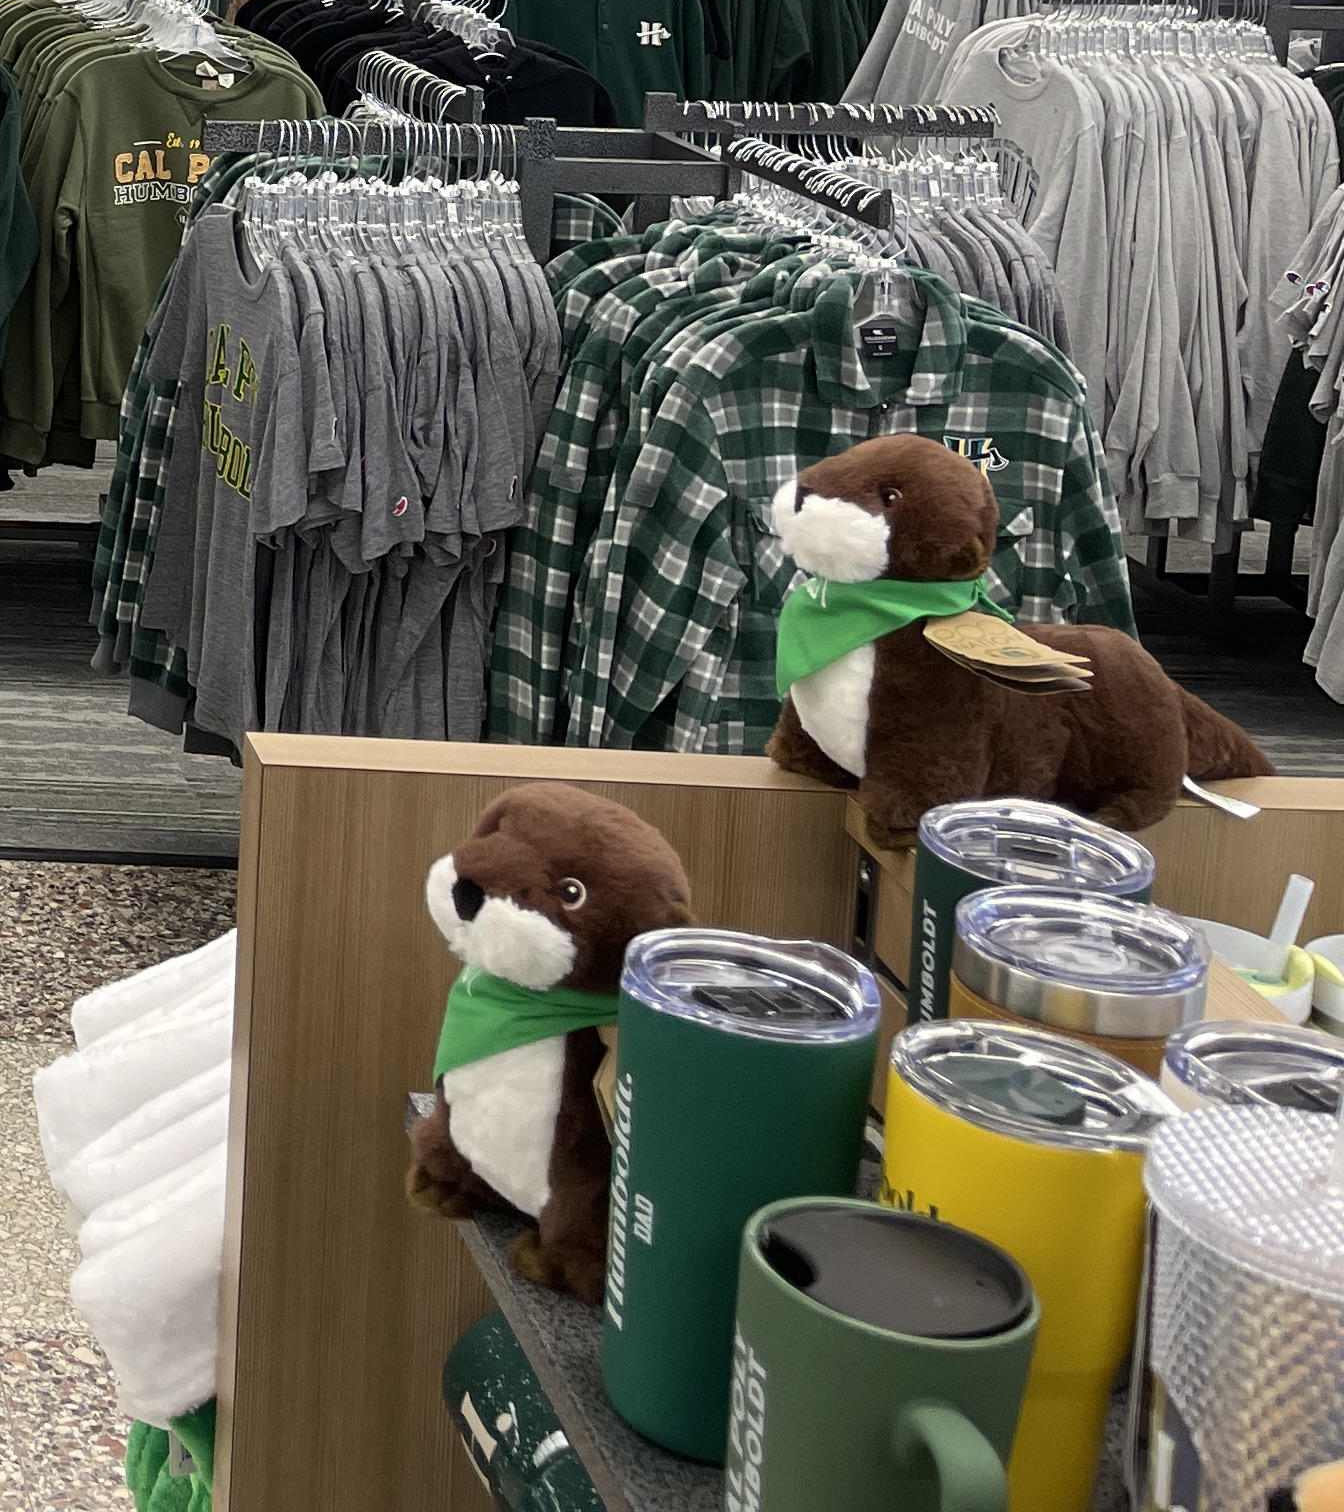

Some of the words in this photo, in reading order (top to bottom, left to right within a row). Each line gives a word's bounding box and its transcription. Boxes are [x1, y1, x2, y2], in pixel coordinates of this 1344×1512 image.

[114, 149, 172, 184] CAL
[606, 1072, 633, 1332] Humboldt.
[633, 1193, 654, 1246] DAD
